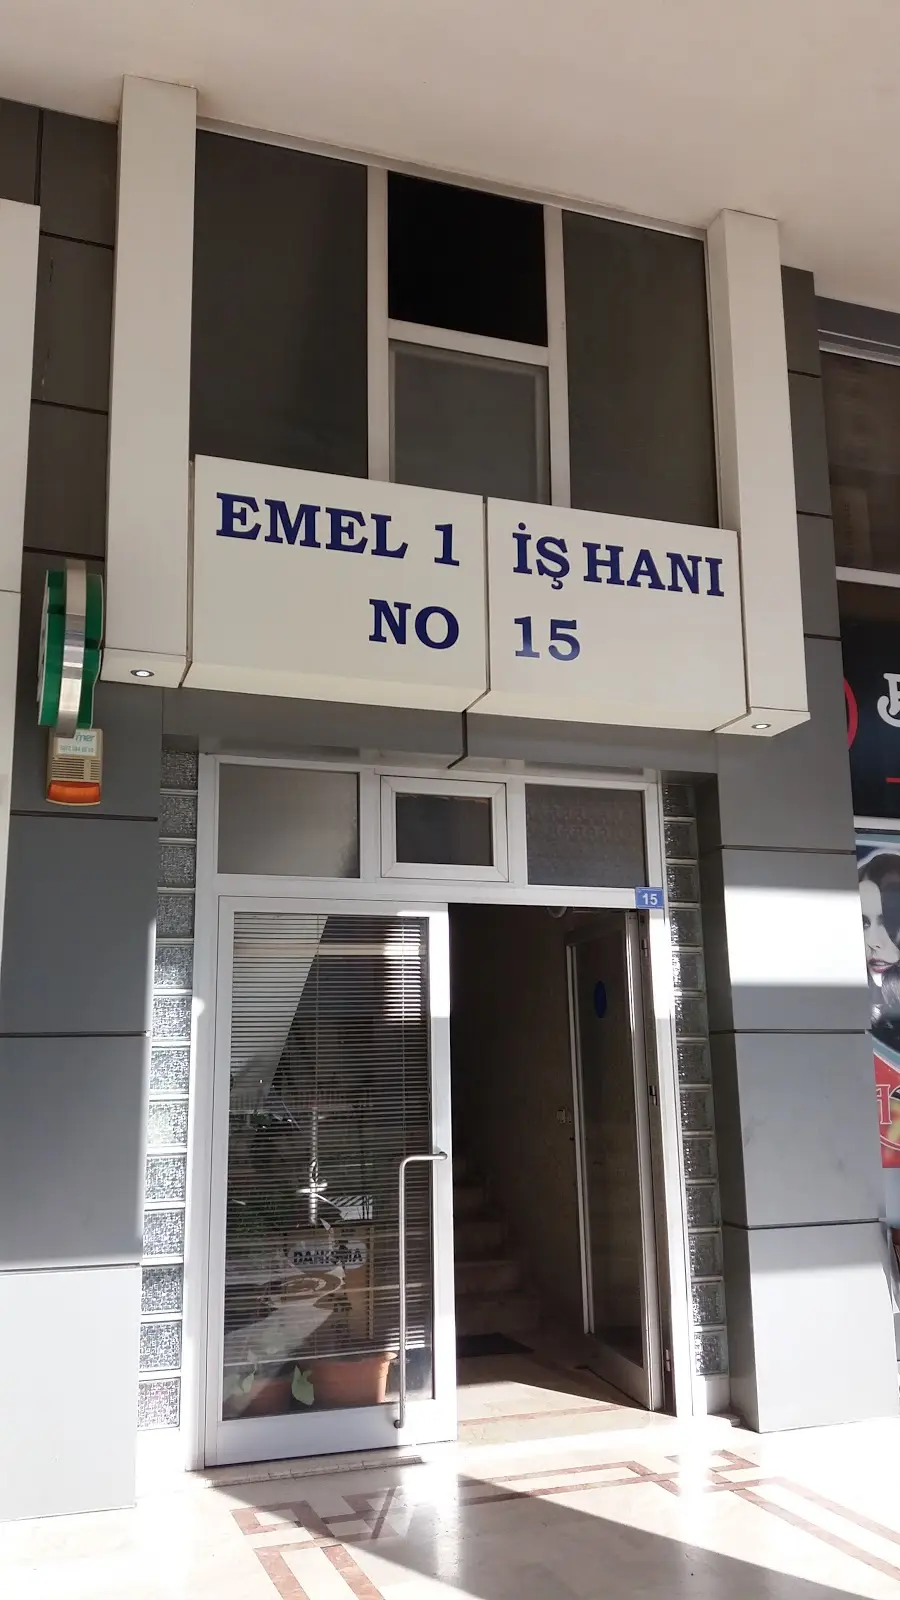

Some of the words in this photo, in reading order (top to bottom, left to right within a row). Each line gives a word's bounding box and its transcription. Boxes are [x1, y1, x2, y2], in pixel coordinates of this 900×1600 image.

[215, 492, 409, 559] EMEL
[433, 522, 461, 566] 1
[511, 521, 571, 589] İŞ
[582, 541, 725, 597] HANI
[368, 598, 460, 650] NO
[513, 615, 582, 662] 15
[642, 892, 658, 906] 15
